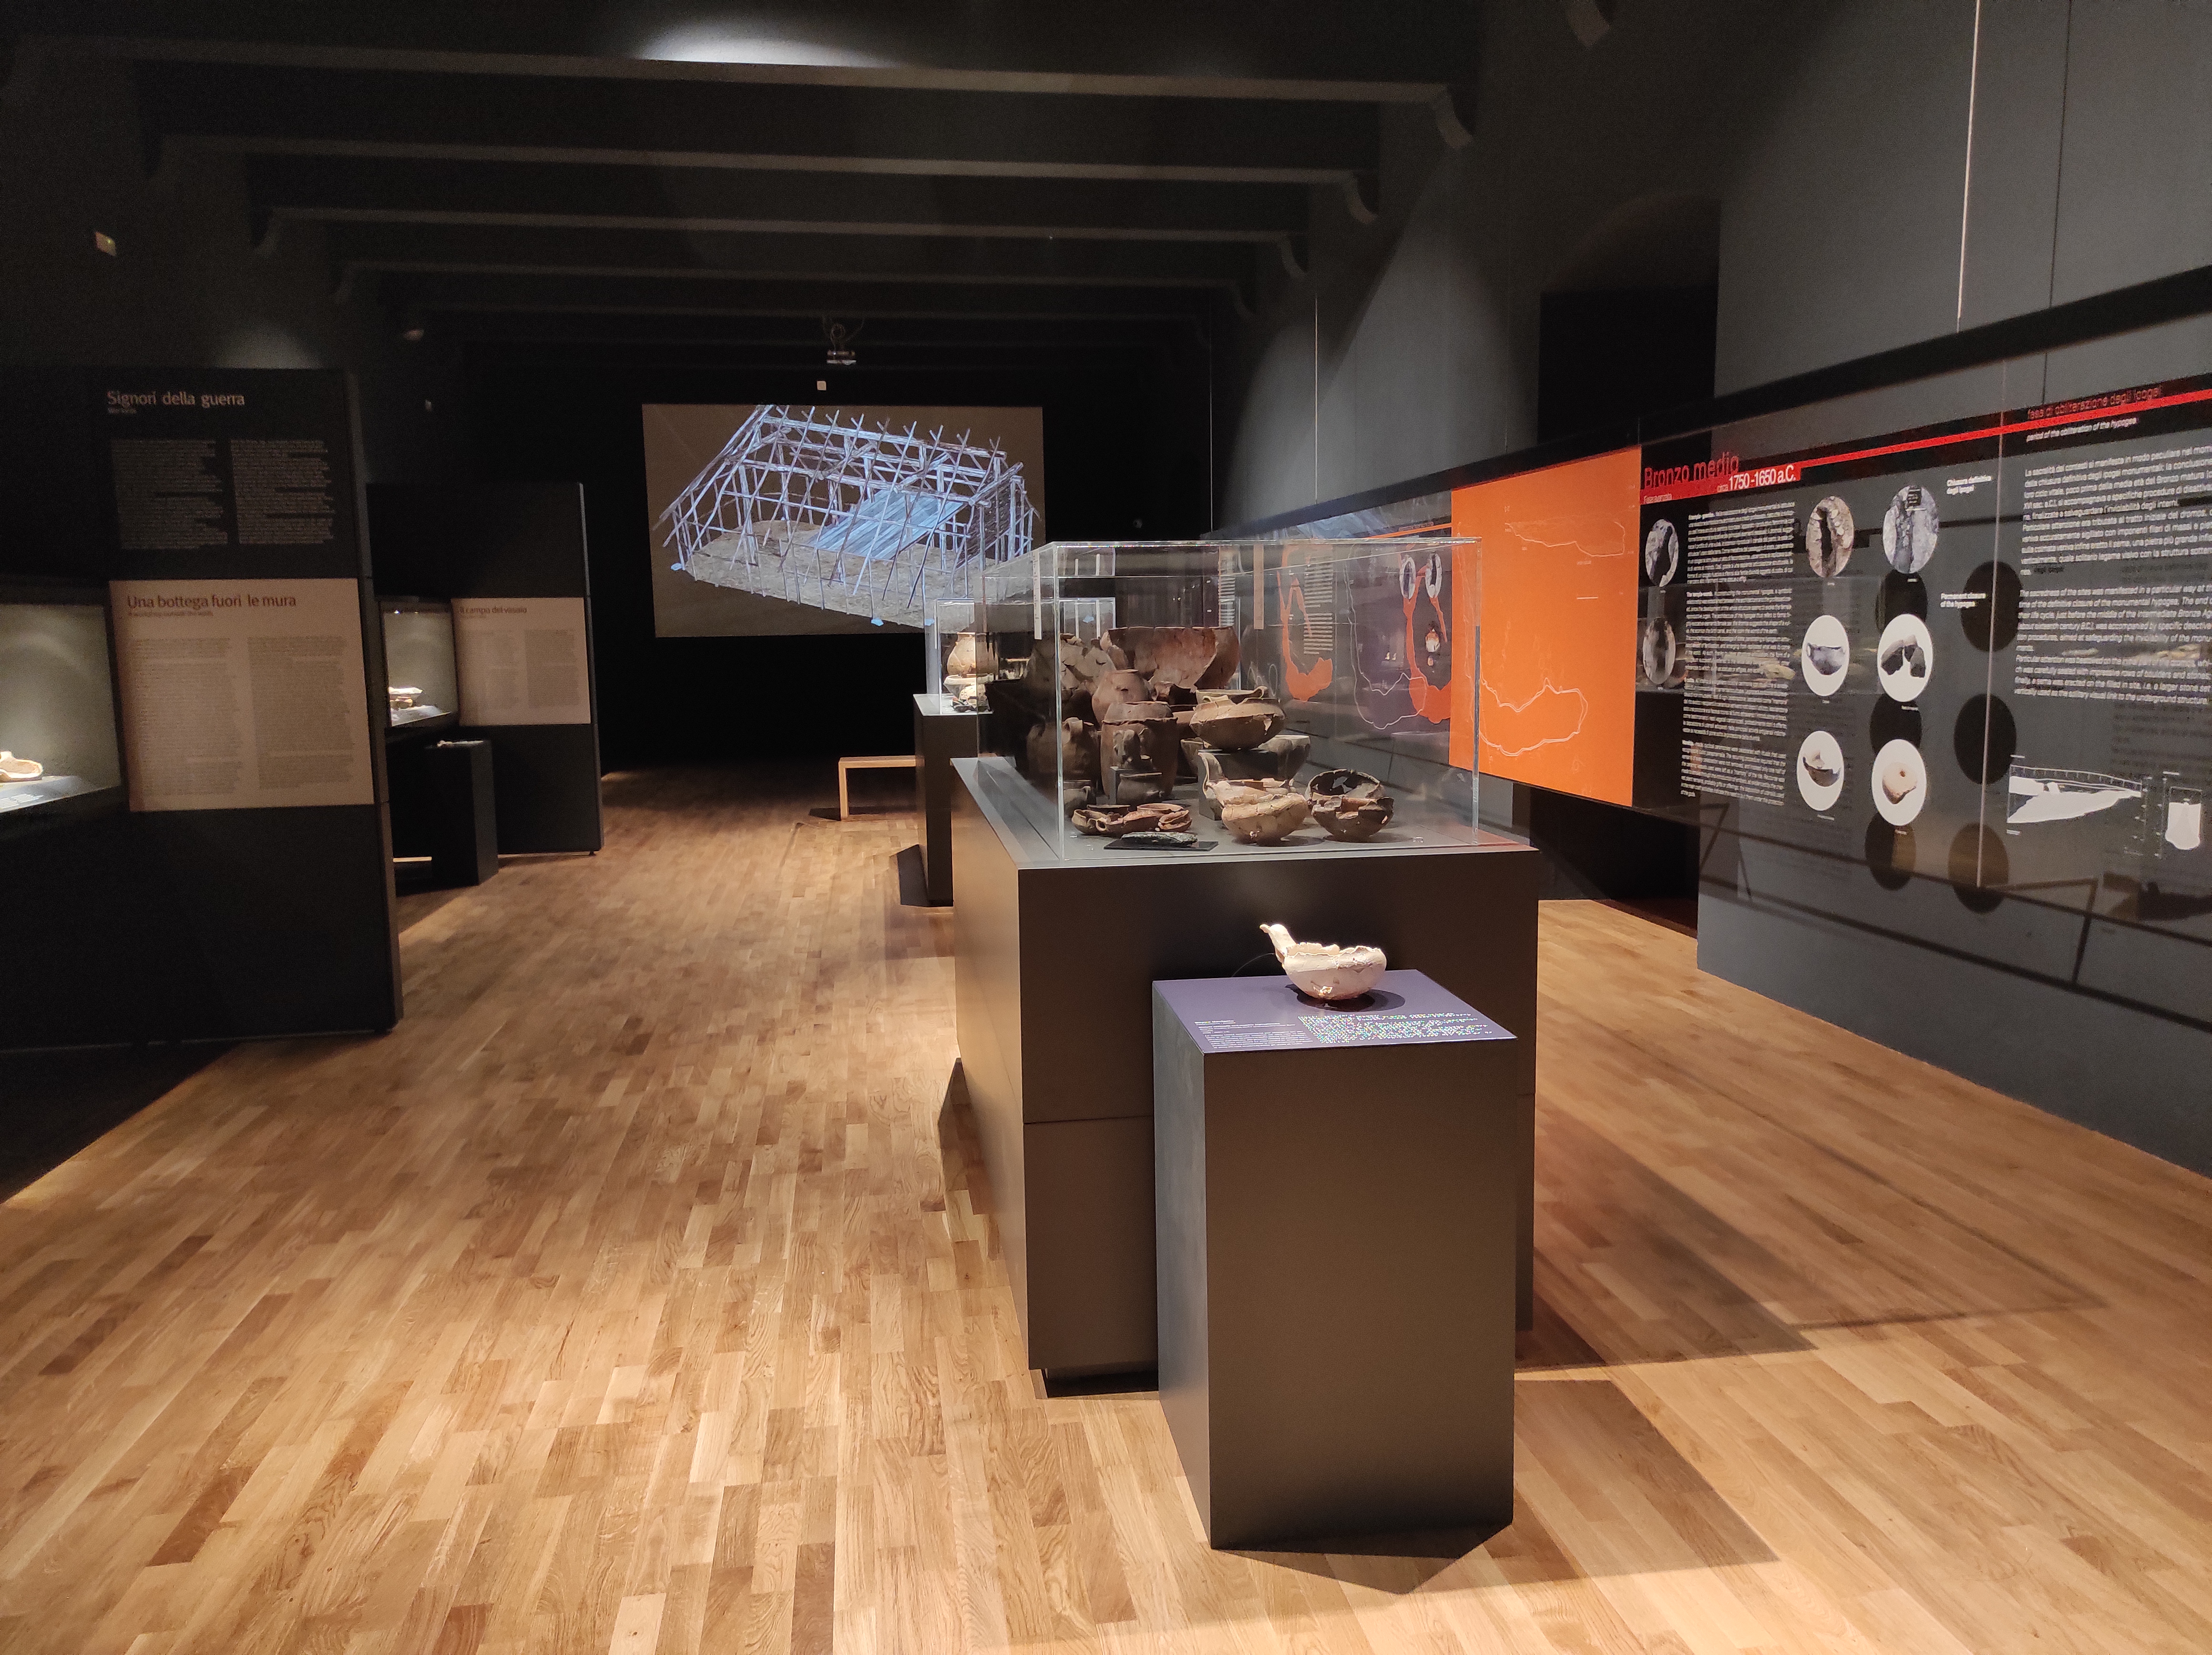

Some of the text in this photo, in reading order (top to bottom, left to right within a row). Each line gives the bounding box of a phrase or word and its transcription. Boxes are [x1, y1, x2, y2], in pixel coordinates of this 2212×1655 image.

[107, 391, 245, 408] Signori della guerra
[1643, 452, 1739, 490] Bronzo medio
[128, 593, 297, 610] Una bottega fuori le mura
